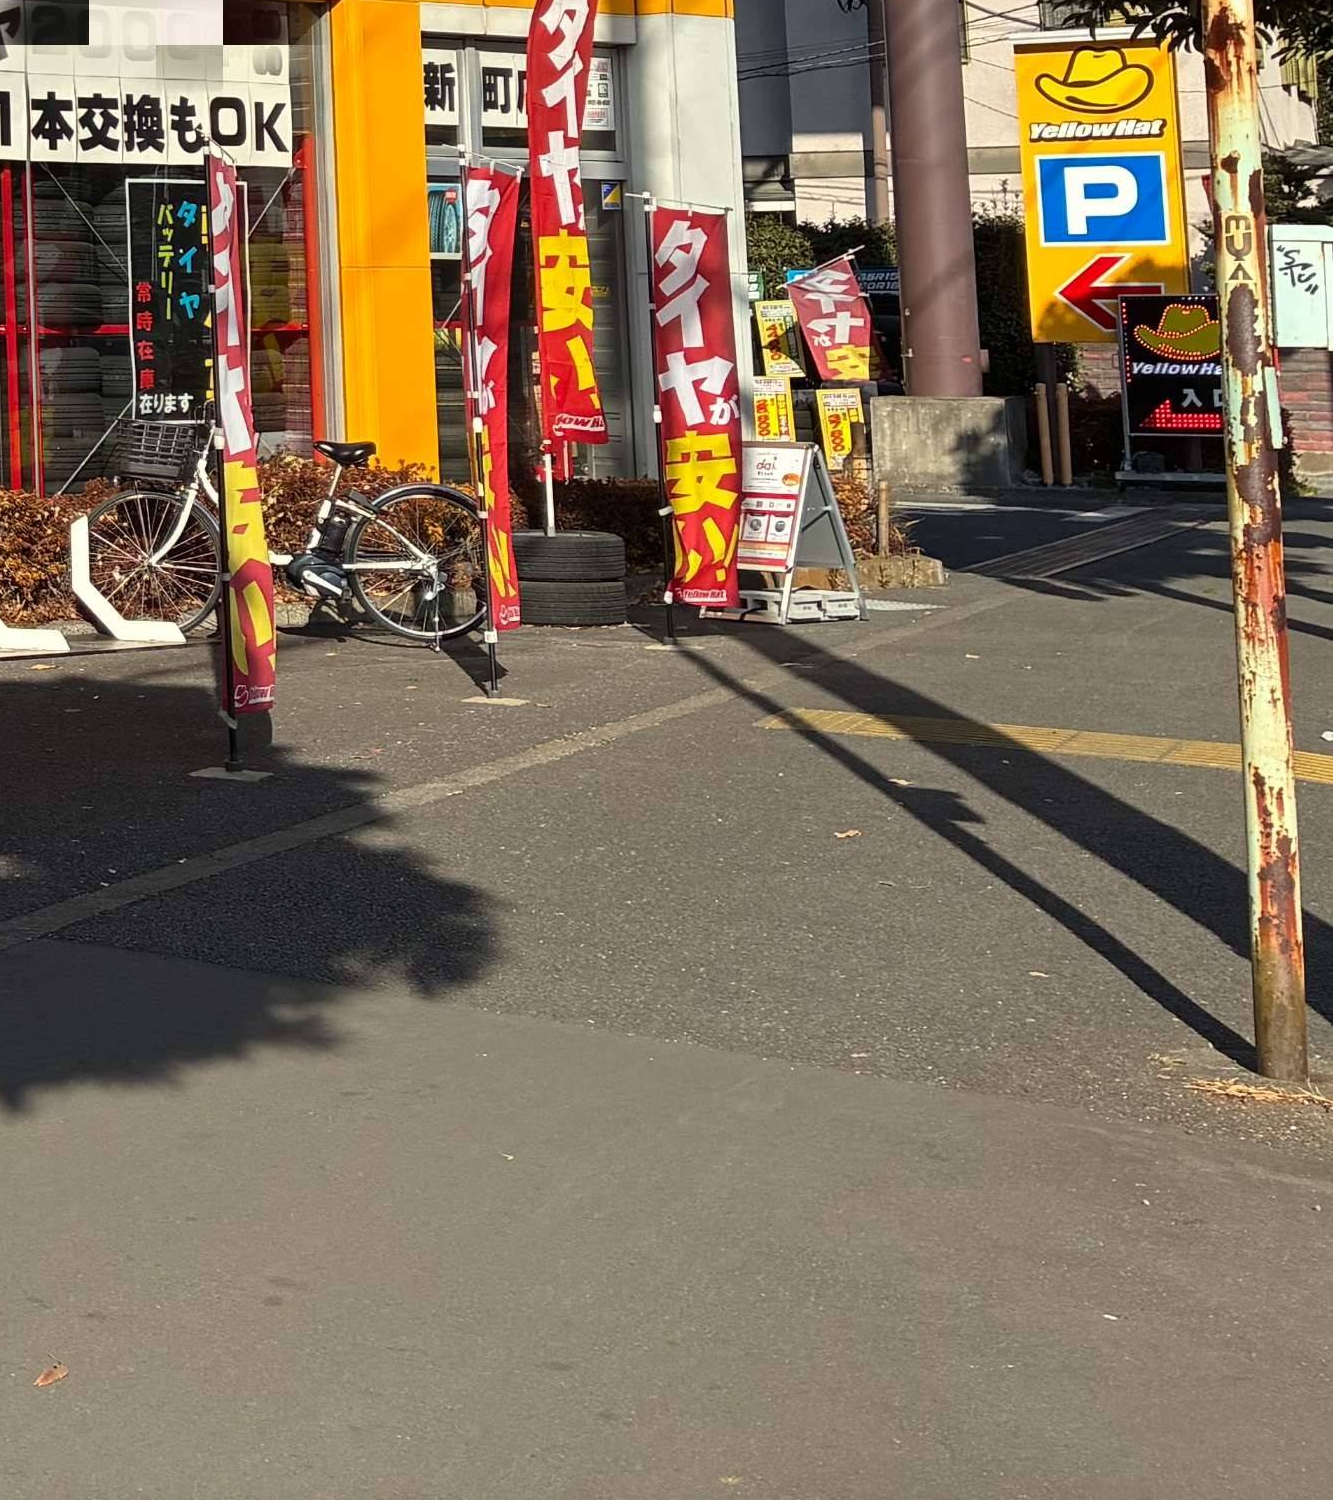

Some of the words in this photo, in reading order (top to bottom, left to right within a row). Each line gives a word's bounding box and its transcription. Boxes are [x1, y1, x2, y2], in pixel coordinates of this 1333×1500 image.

[1028, 118, 1166, 142] YellowHat
[1064, 163, 1139, 236] P
[157, 203, 175, 321] バッテリー
[176, 200, 200, 320] タイヤ
[135, 281, 155, 390] 常時在庫
[1132, 361, 1222, 377] YellowHa
[139, 393, 194, 415] 在ります
